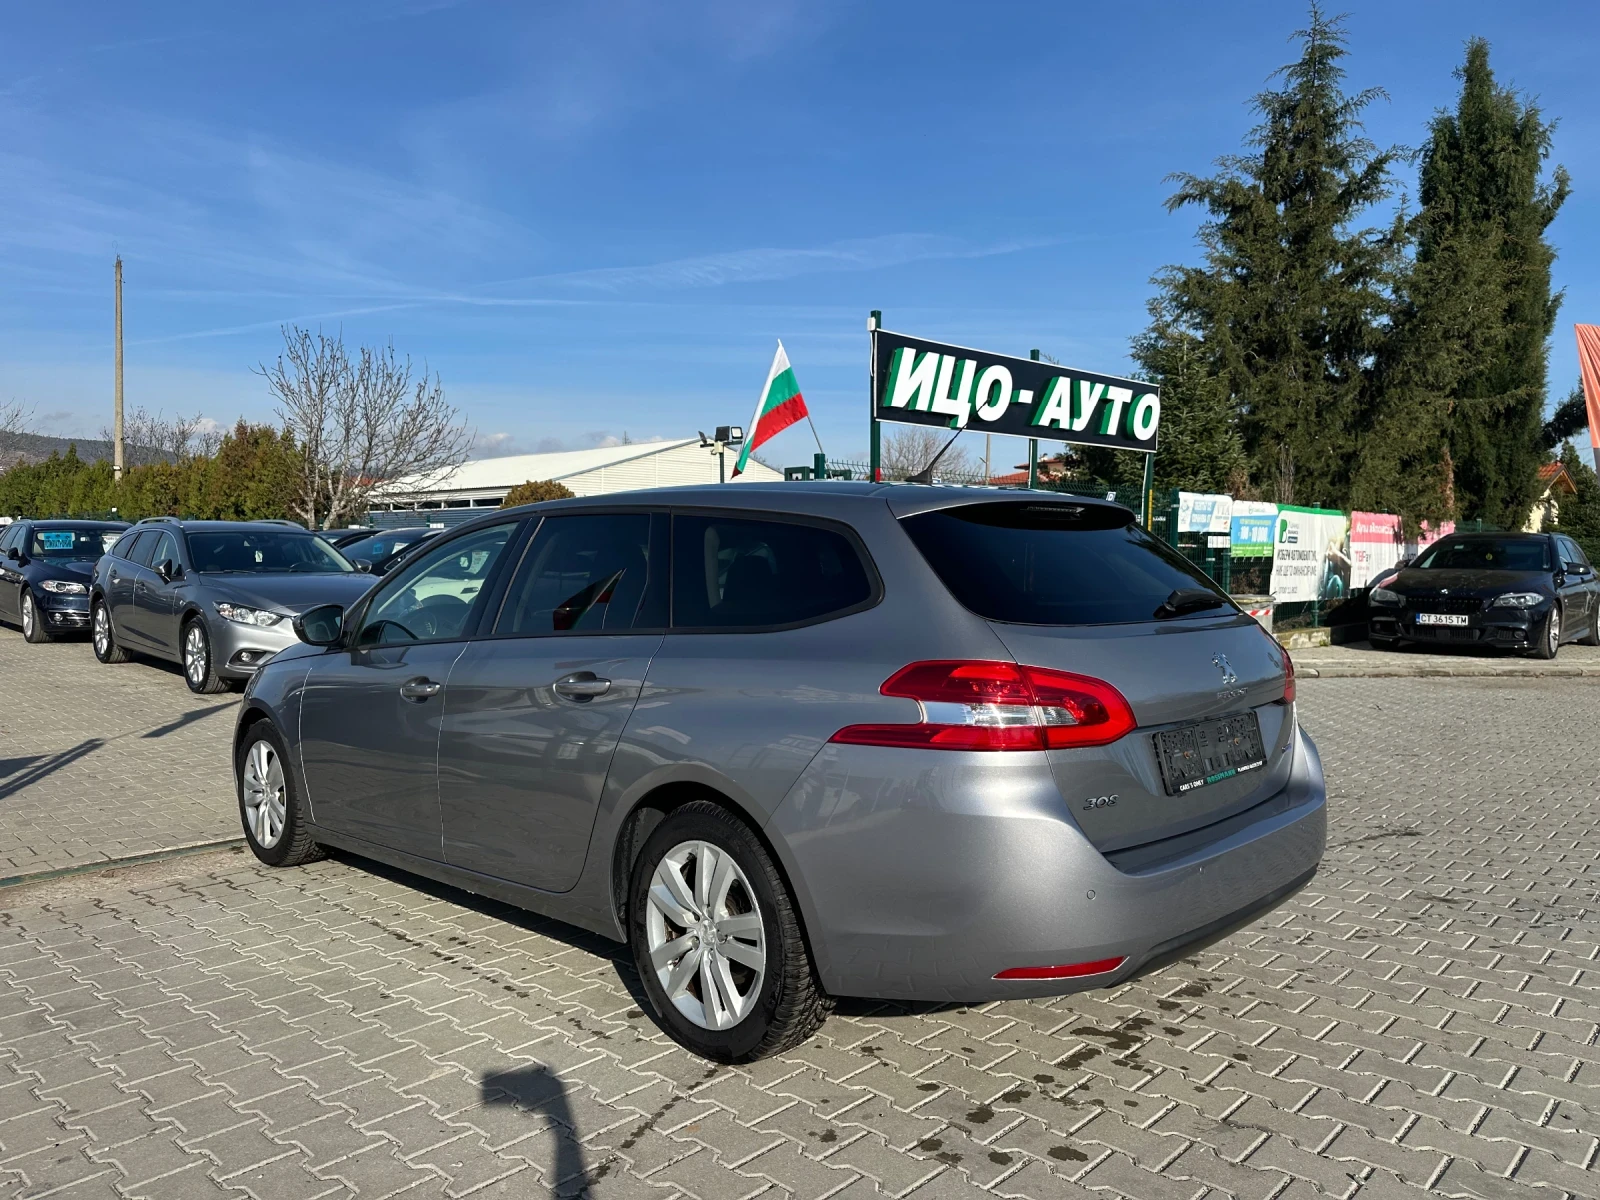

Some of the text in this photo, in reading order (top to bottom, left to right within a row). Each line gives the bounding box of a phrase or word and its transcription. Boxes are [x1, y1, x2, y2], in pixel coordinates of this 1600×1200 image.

[1420, 614, 1467, 625] CT 3615 TM
[1083, 794, 1119, 811] 308
